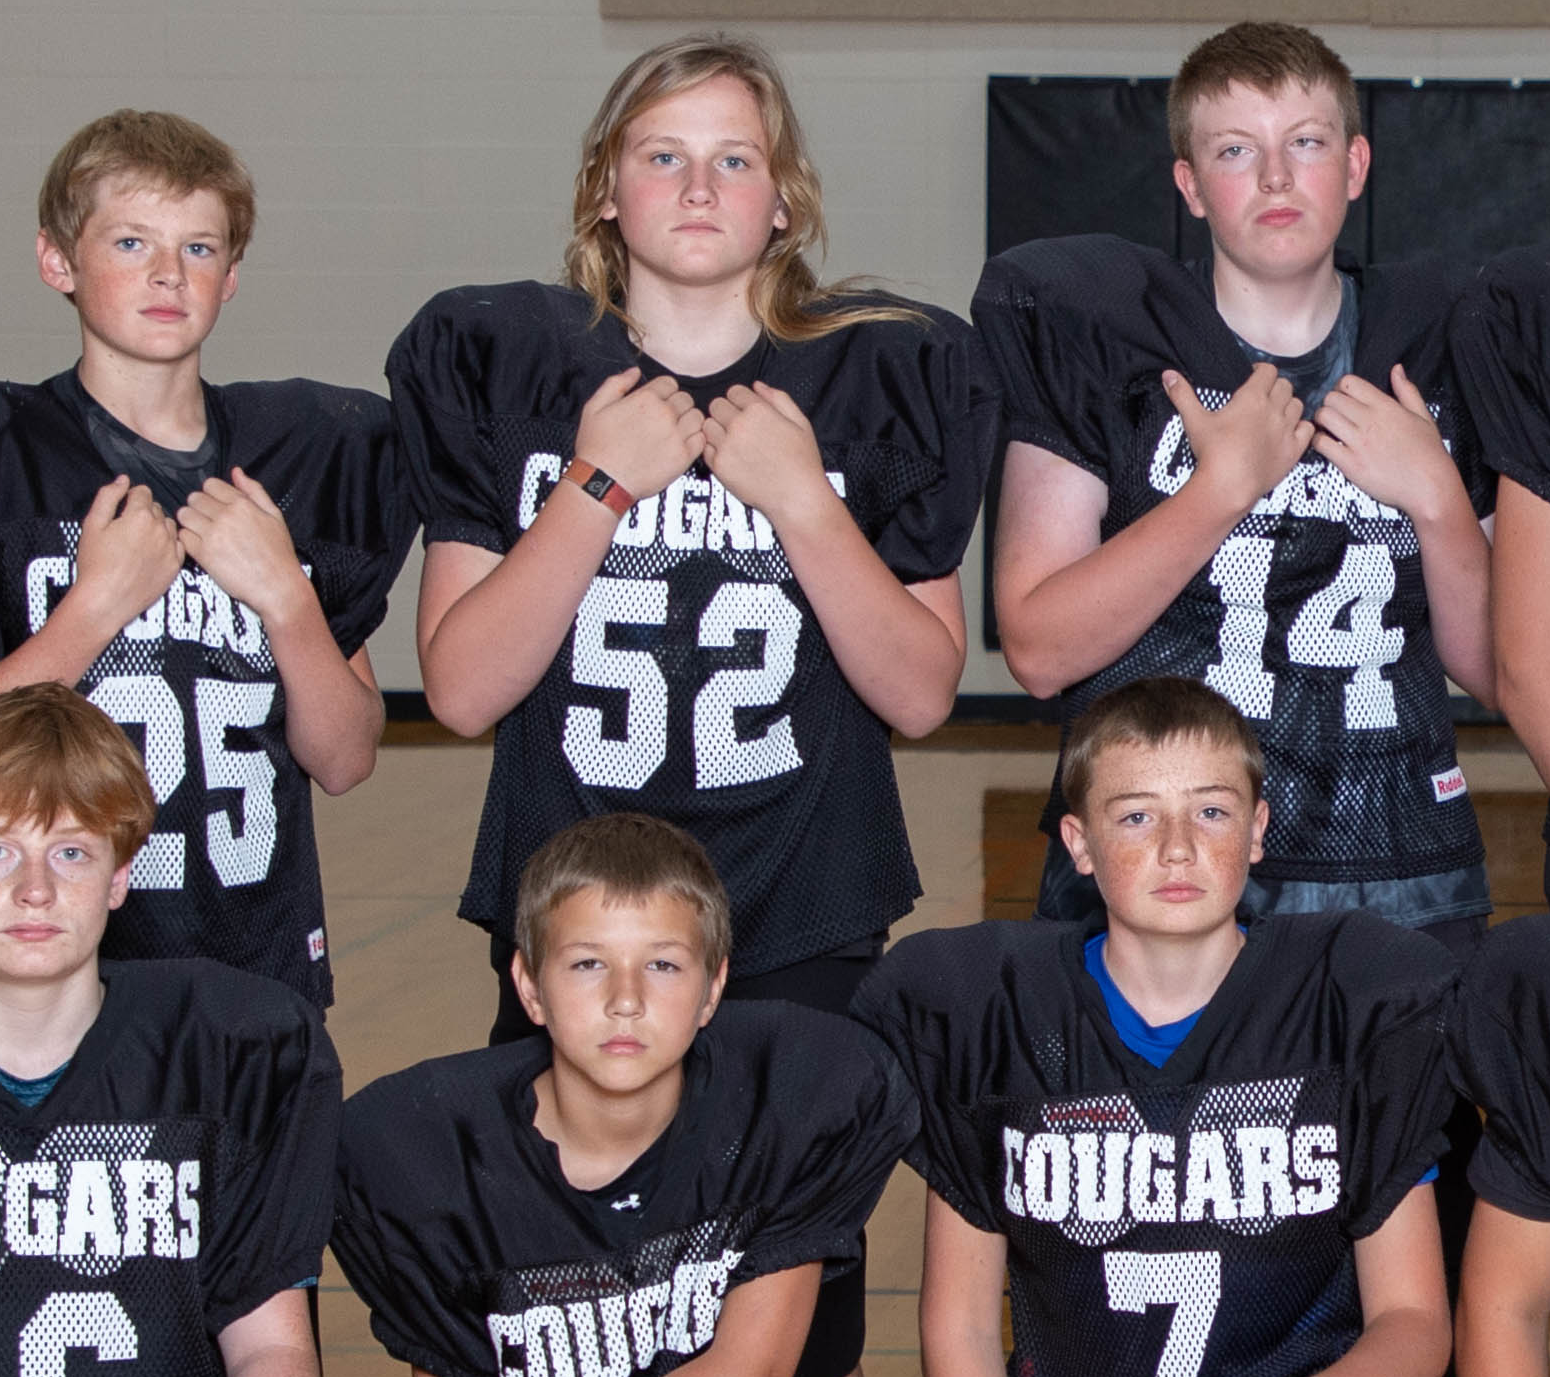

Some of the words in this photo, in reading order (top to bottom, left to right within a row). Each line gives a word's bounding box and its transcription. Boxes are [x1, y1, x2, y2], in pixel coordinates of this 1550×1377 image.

[562, 576, 804, 790] 52
[1205, 537, 1405, 729] 14
[1003, 1124, 1342, 1223] COUGARS
